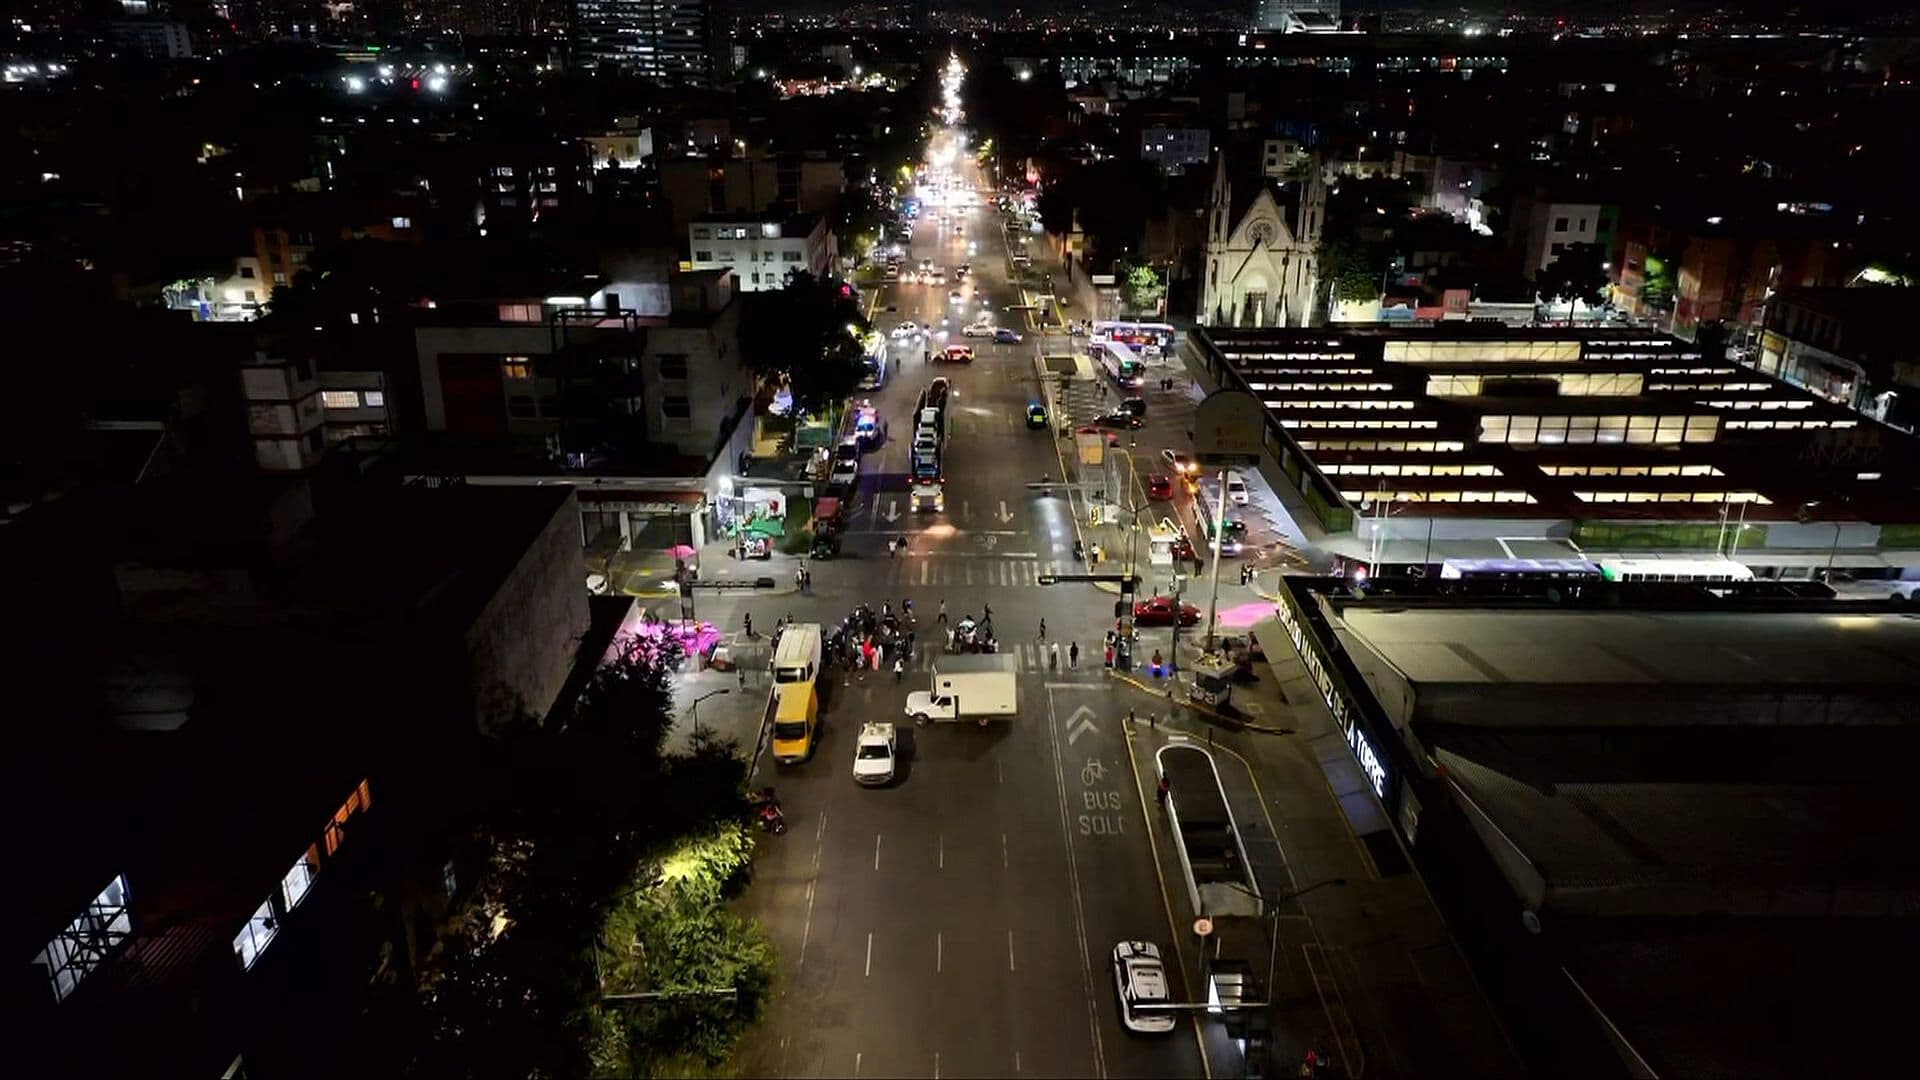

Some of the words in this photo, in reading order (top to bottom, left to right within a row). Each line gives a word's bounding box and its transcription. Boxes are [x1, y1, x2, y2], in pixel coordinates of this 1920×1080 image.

[1343, 709, 1355, 748] LA
[1356, 728, 1386, 799] TORRE
[1083, 791, 1121, 810] BUS
